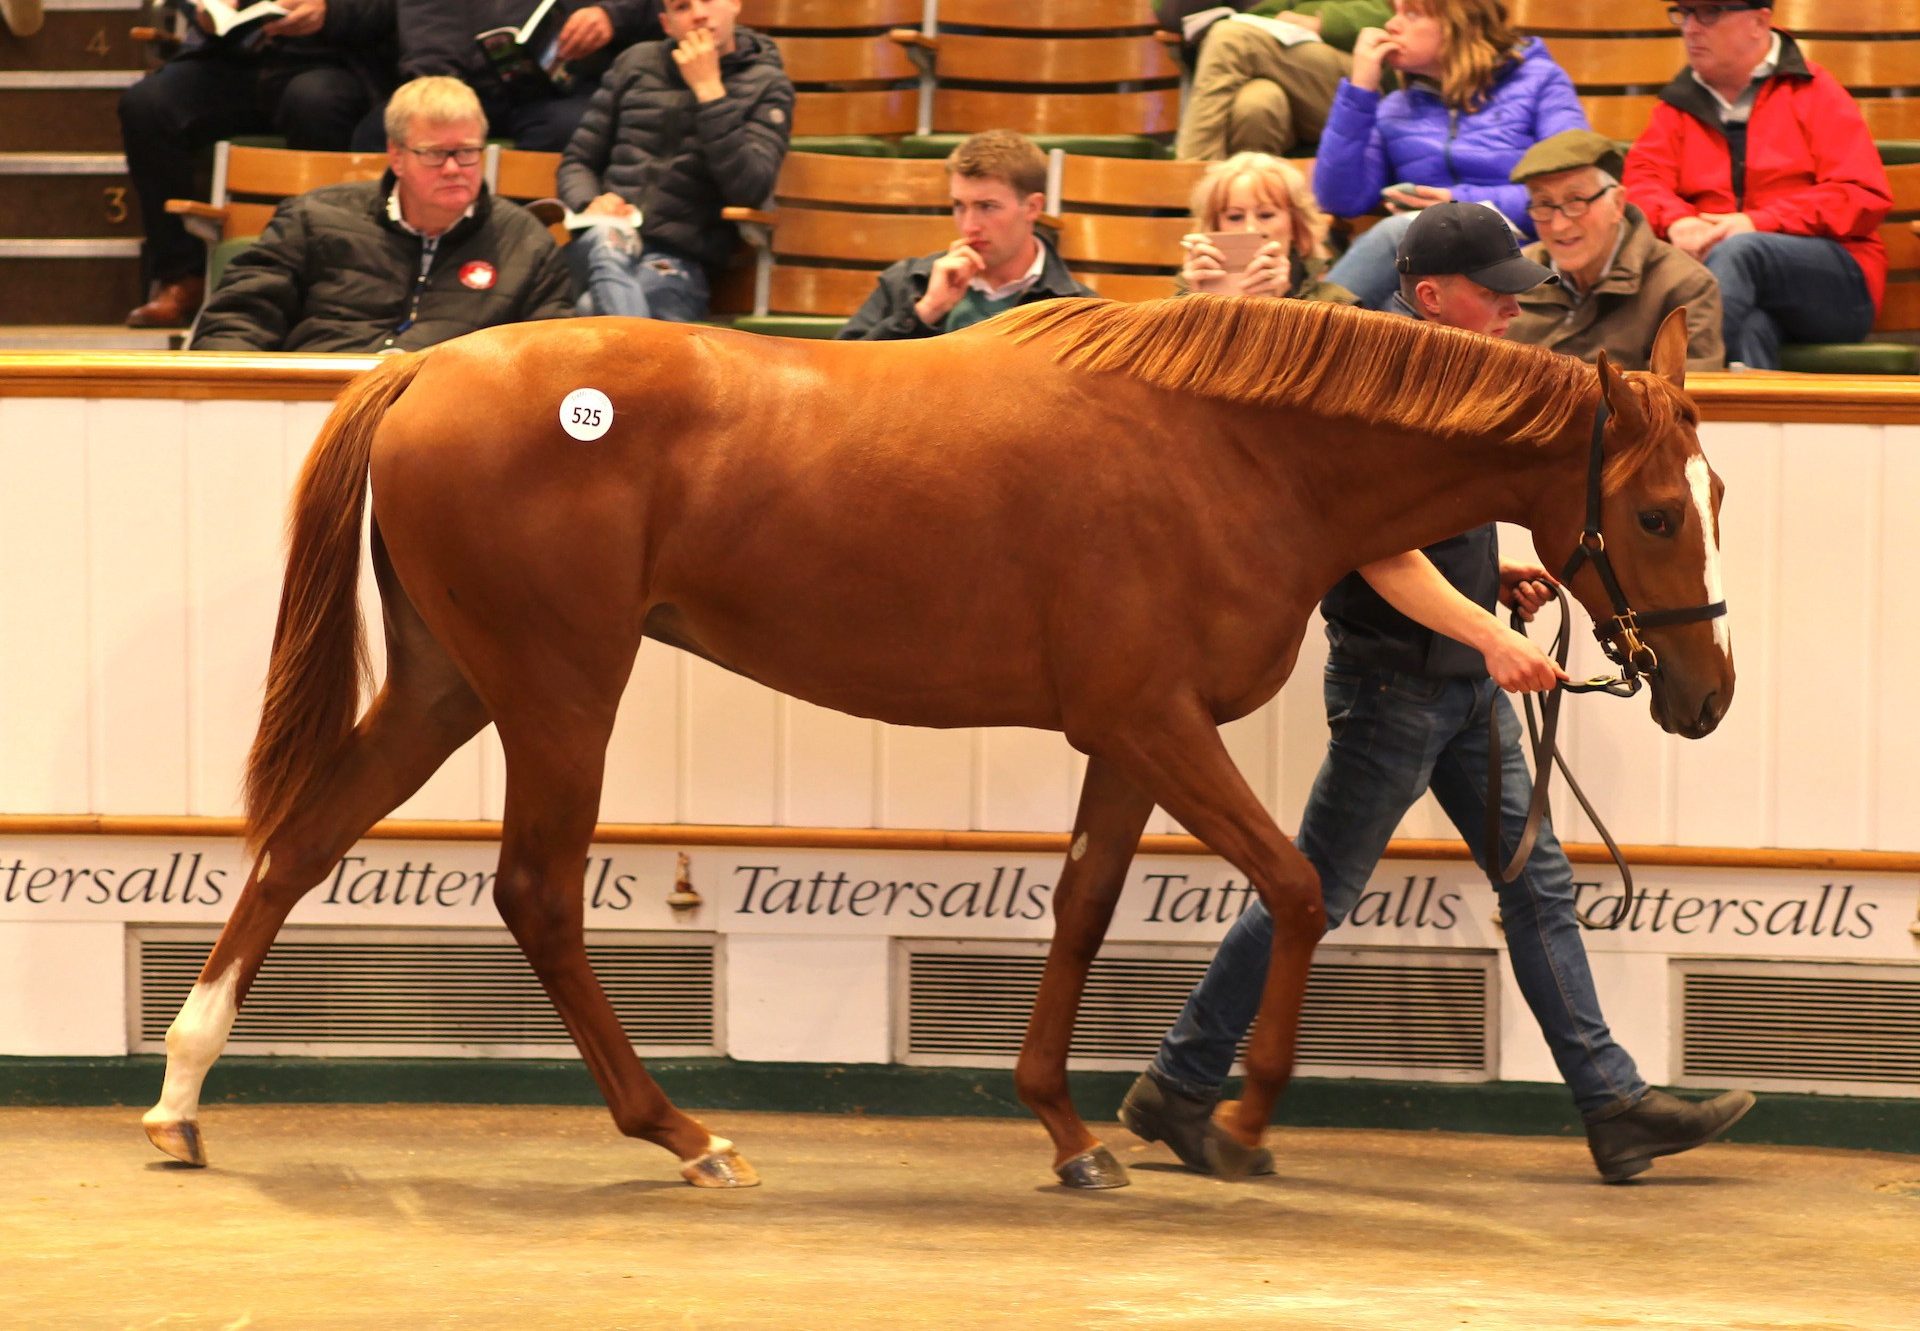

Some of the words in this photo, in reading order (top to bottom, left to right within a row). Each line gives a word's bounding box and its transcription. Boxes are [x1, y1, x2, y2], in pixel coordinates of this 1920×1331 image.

[85, 29, 111, 56] 4
[103, 186, 128, 224] 3
[572, 406, 602, 427] 525
[0, 852, 227, 905] tersalls
[733, 865, 1051, 920] Tattersalls
[1142, 874, 1461, 930] Tattalls
